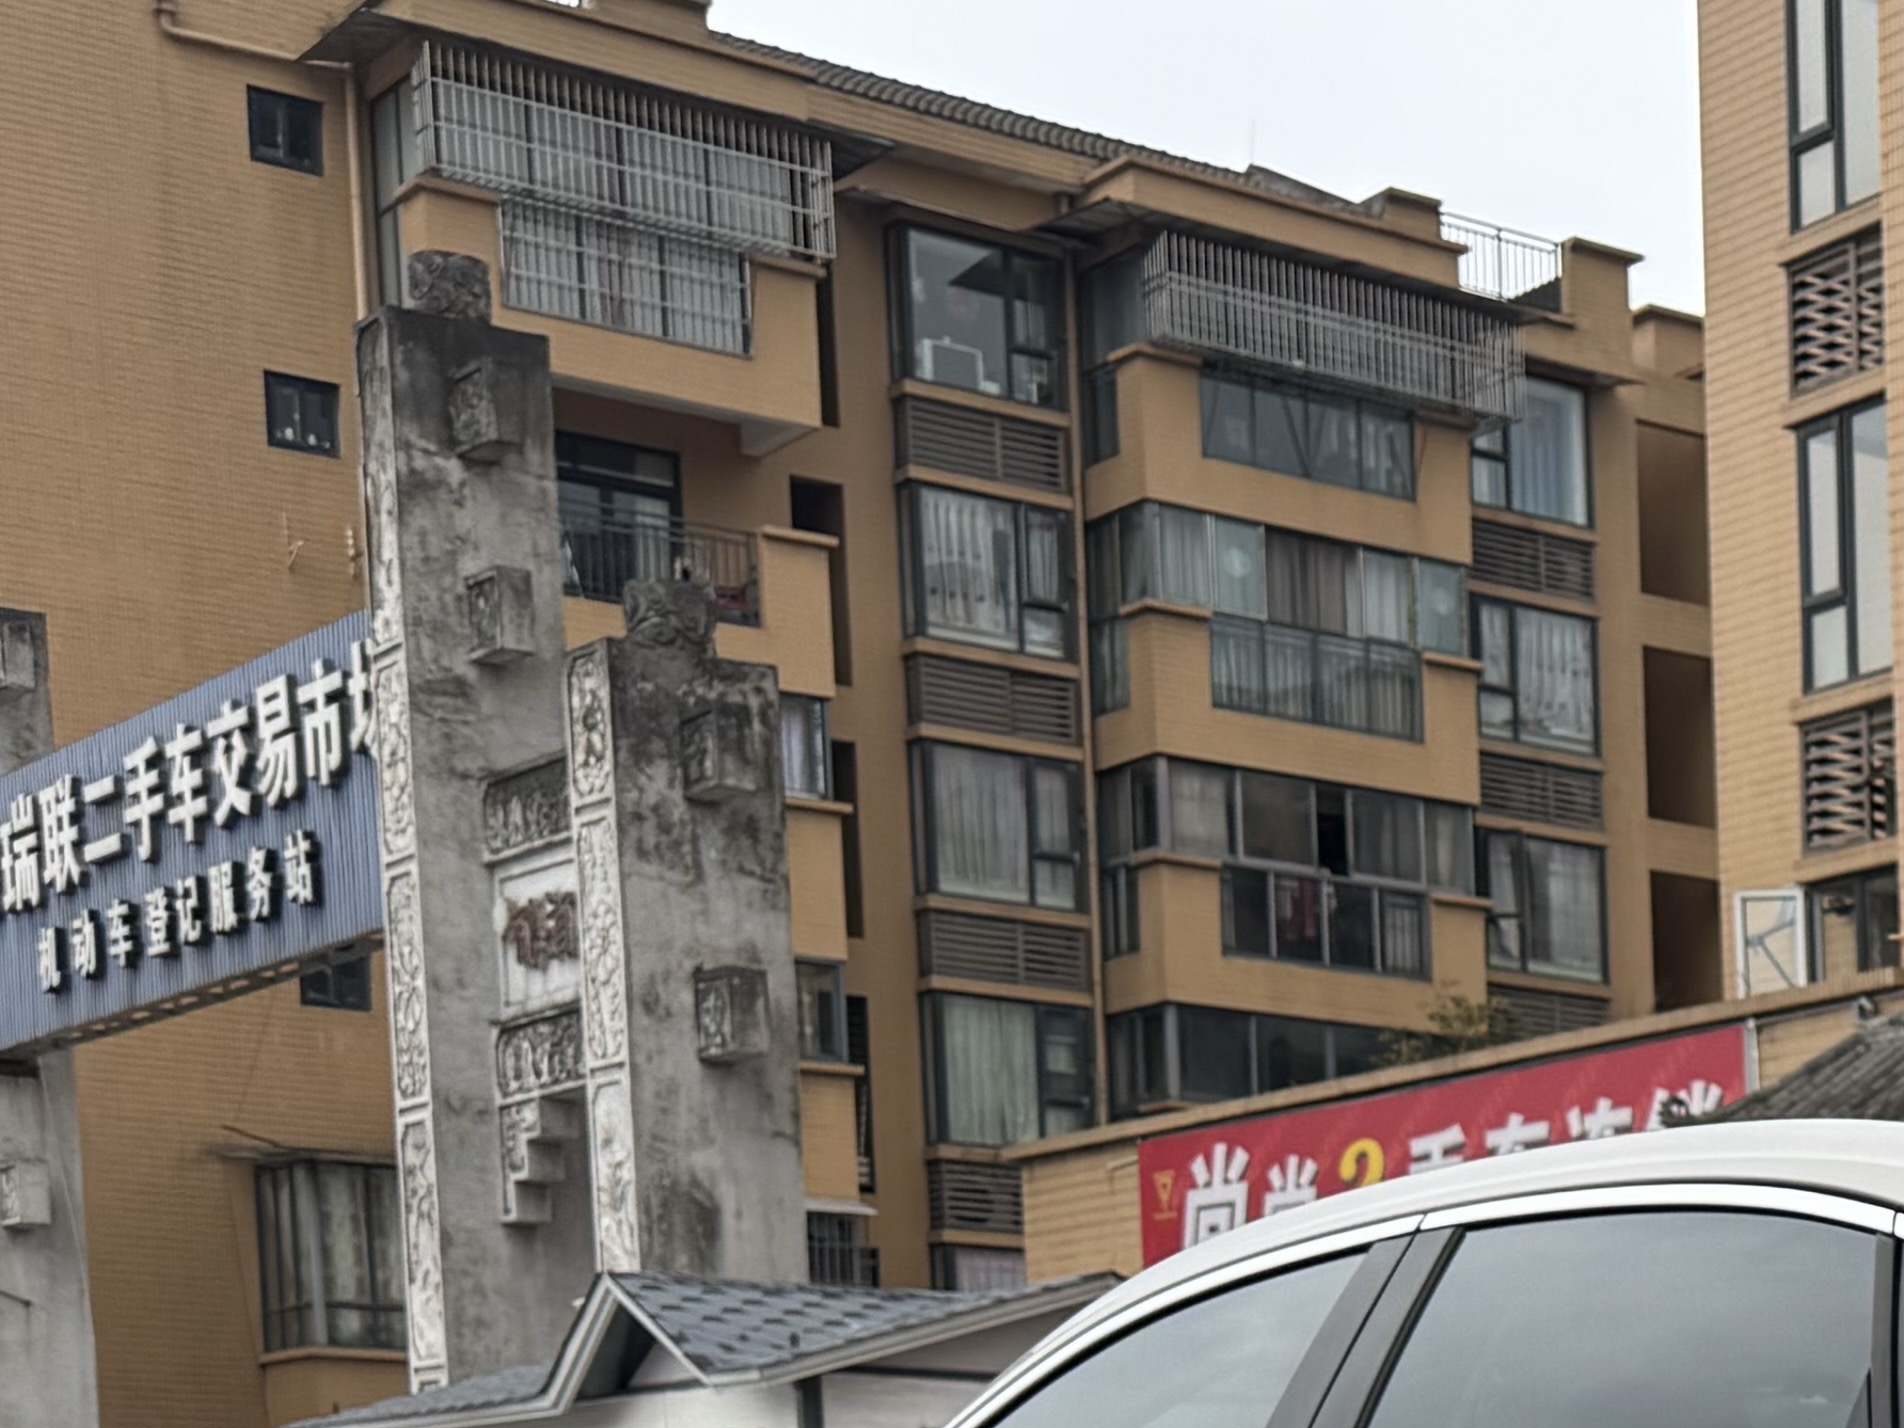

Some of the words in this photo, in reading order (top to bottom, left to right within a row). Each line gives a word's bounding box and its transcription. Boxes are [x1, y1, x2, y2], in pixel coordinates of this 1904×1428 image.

[38, 829, 314, 992] 机动车登记服务站
